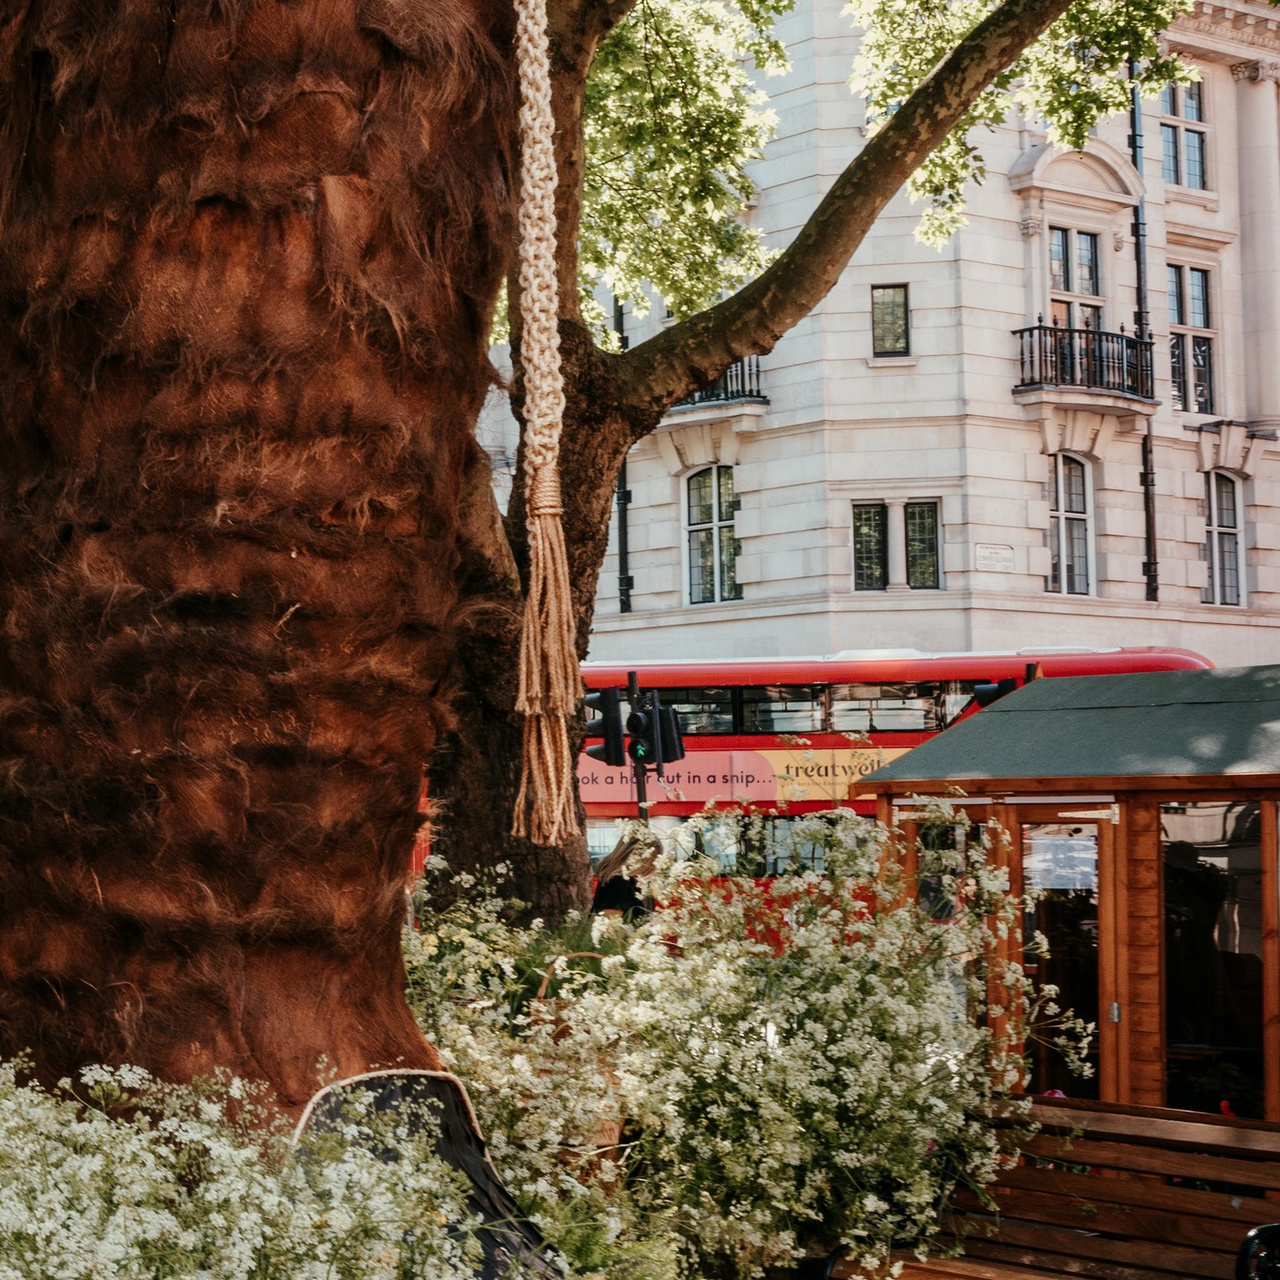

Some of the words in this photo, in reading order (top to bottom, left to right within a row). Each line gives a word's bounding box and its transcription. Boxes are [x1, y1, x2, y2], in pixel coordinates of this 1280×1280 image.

[605, 775, 614, 785] a
[620, 771, 652, 785] har
[687, 771, 702, 784] in
[706, 774, 716, 784] a
